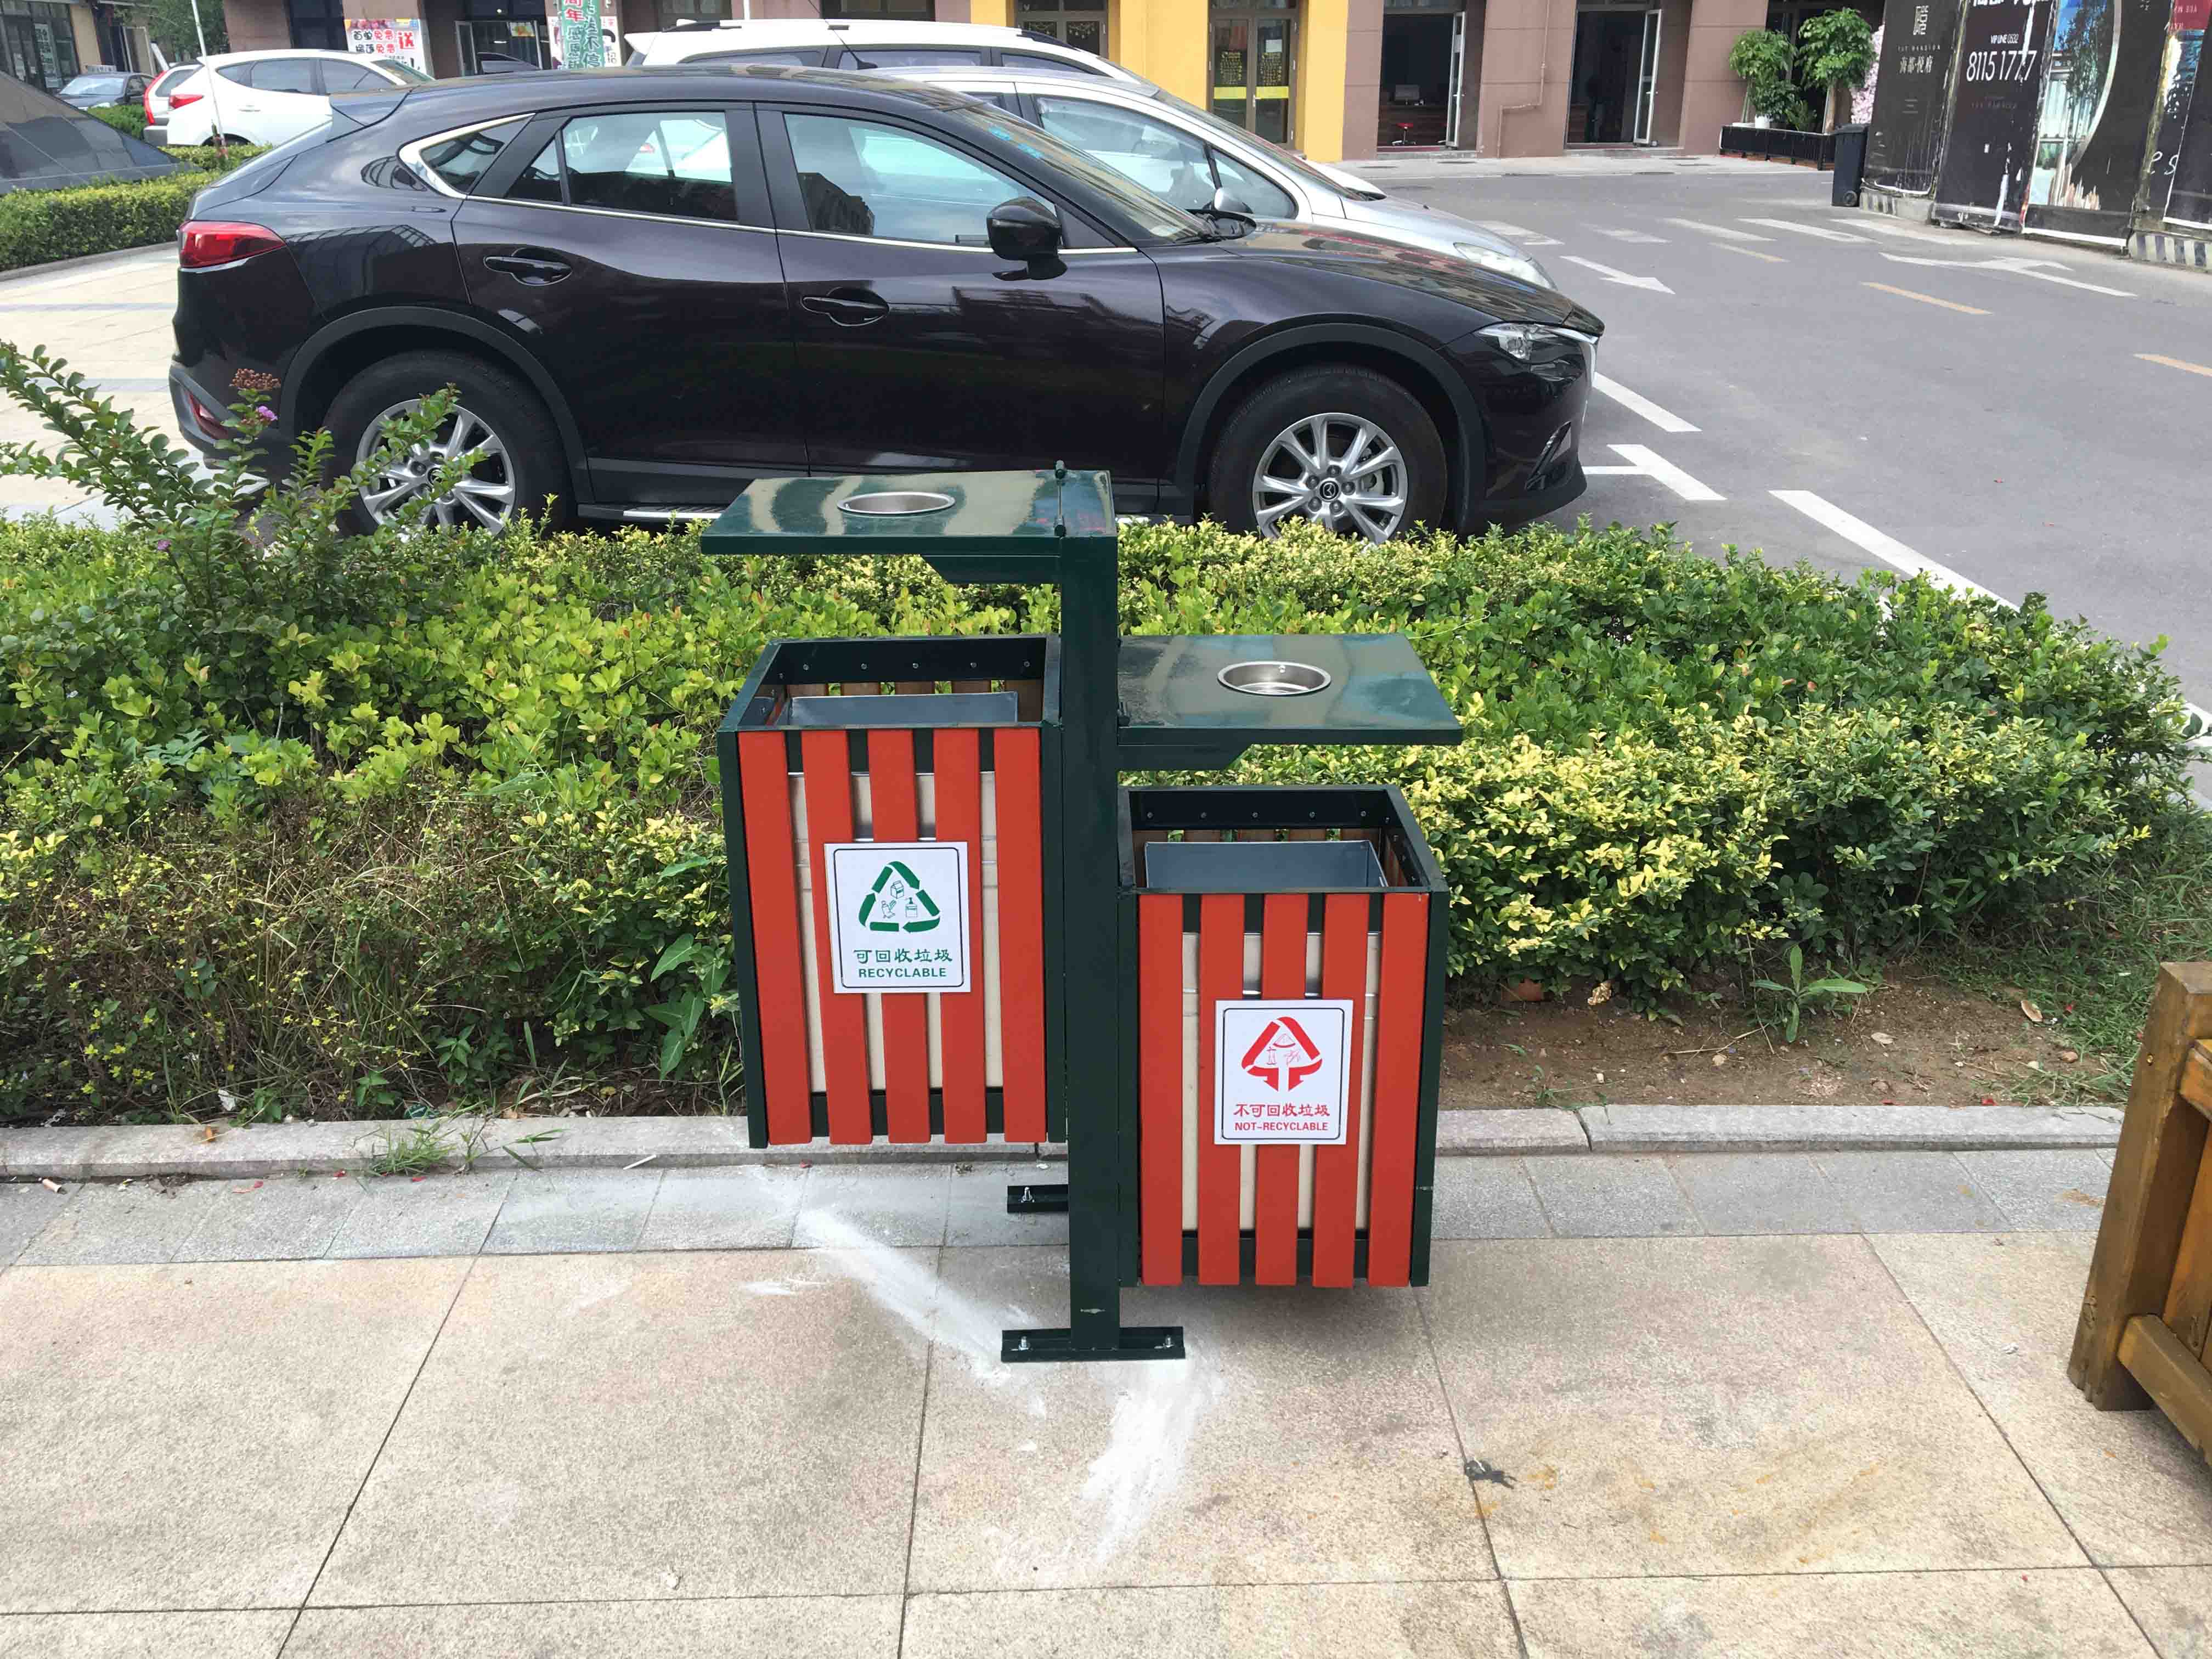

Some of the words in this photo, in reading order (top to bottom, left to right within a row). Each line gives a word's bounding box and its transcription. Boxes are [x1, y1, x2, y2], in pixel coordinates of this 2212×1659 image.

[1966, 50, 1997, 82] 8115
[1999, 50, 2038, 81] 1777
[853, 948, 952, 964] 可回收垃圾
[859, 968, 947, 978] RECYCLABLE
[1233, 1103, 1330, 1118] 不可回收垃圾
[1234, 1122, 1329, 1131] NOT-RECYCLABLE
